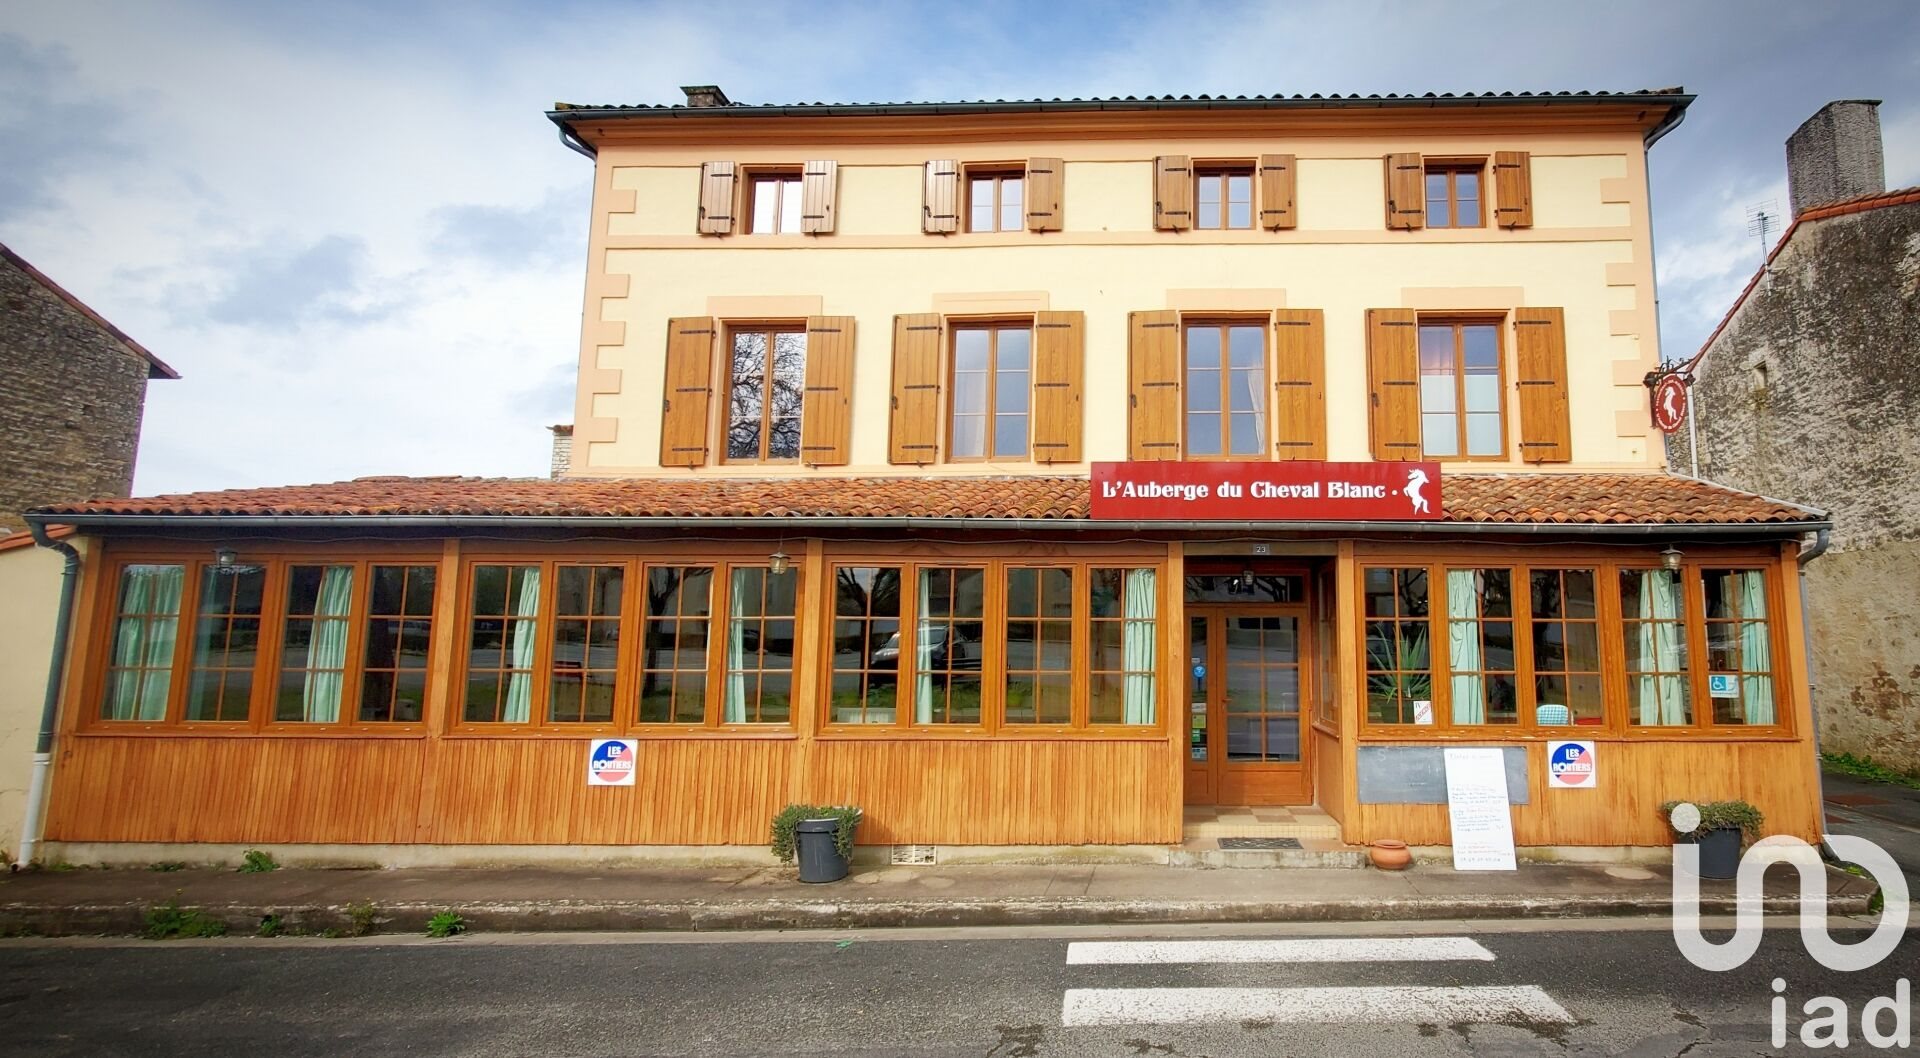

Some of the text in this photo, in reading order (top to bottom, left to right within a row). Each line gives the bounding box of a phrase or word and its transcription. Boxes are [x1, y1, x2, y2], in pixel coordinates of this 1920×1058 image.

[1102, 480, 1386, 501] L'Auberge du Cheval Blanc
[607, 745, 622, 758] LES
[1565, 748, 1580, 761] LES
